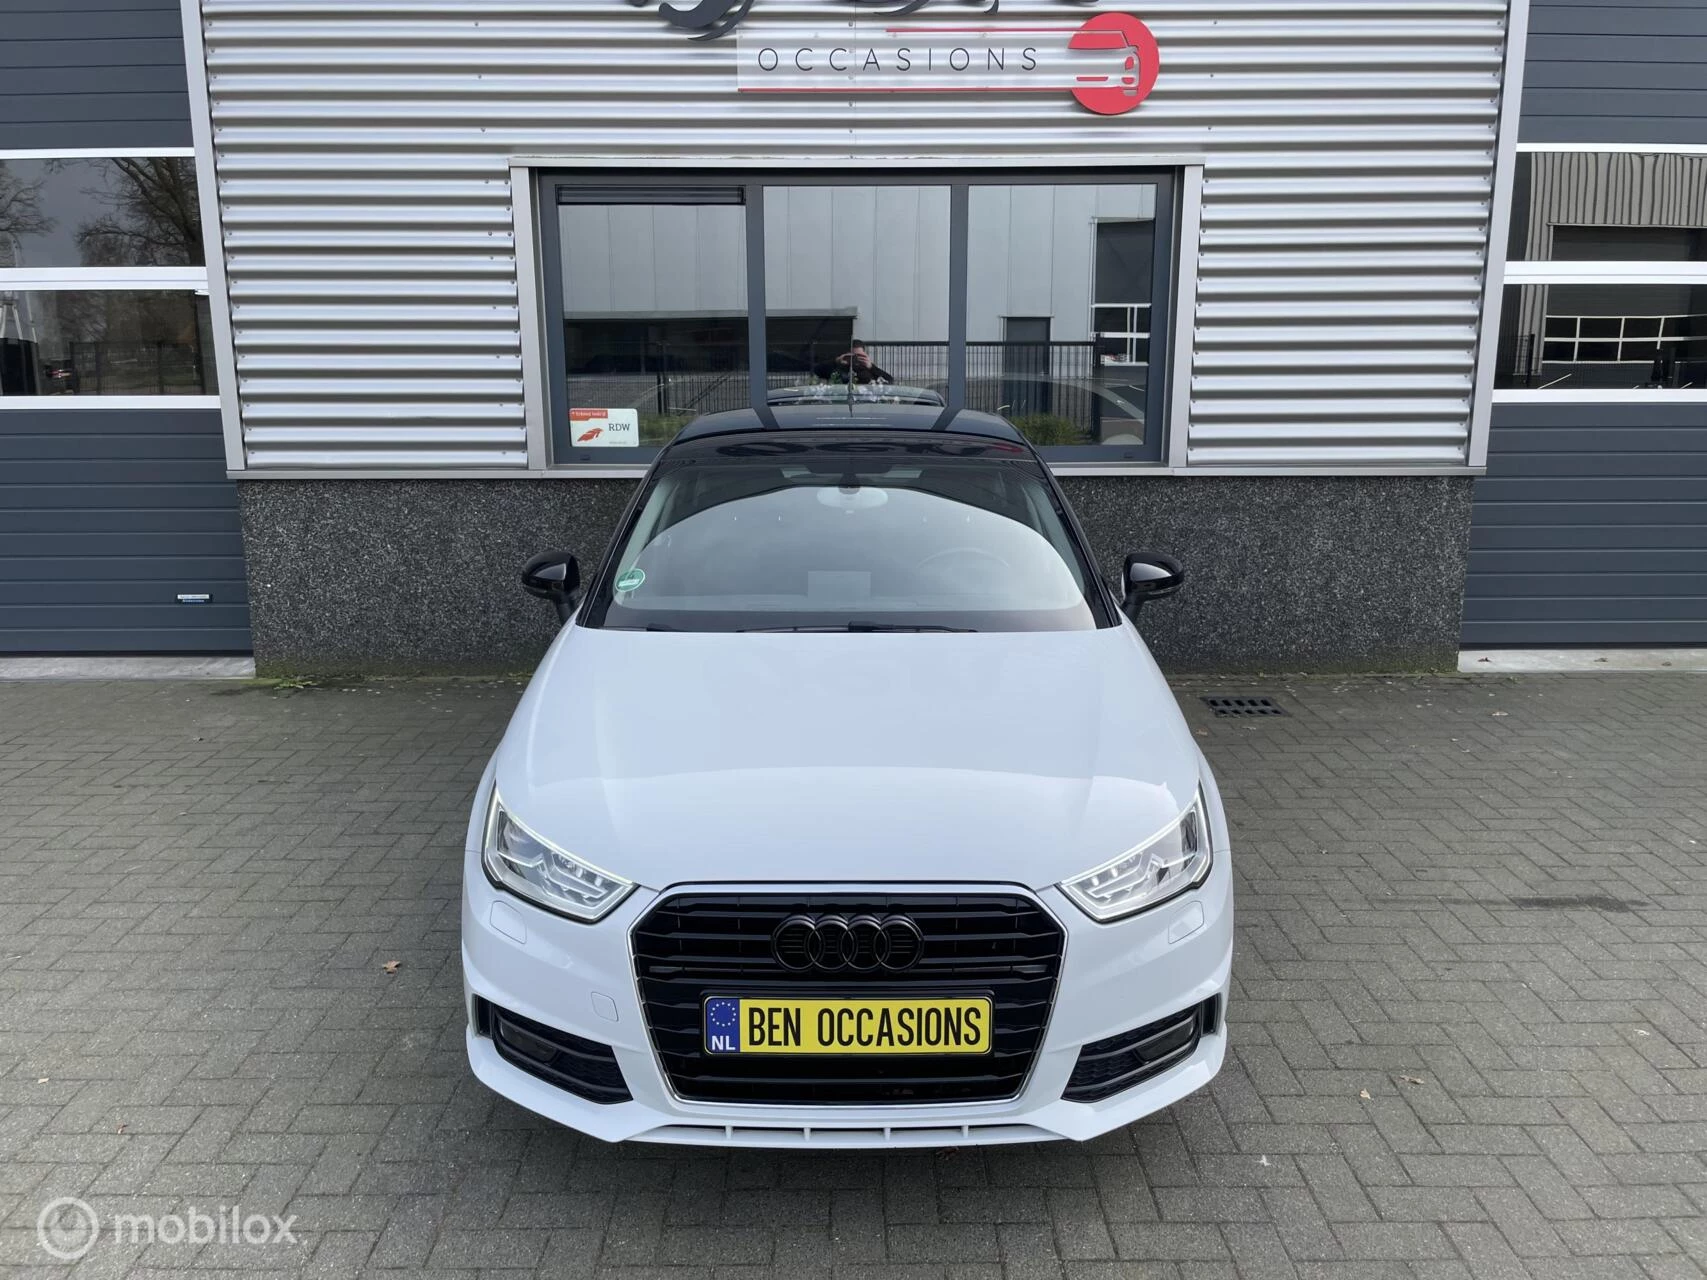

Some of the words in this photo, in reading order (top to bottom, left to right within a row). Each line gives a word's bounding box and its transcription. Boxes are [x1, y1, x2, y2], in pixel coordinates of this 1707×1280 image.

[757, 47, 1037, 72] OCCASIONS
[608, 423, 630, 432] RDW
[748, 1006, 801, 1047] BEN
[817, 1006, 982, 1047] OCCASIONS
[711, 1035, 736, 1051] NL
